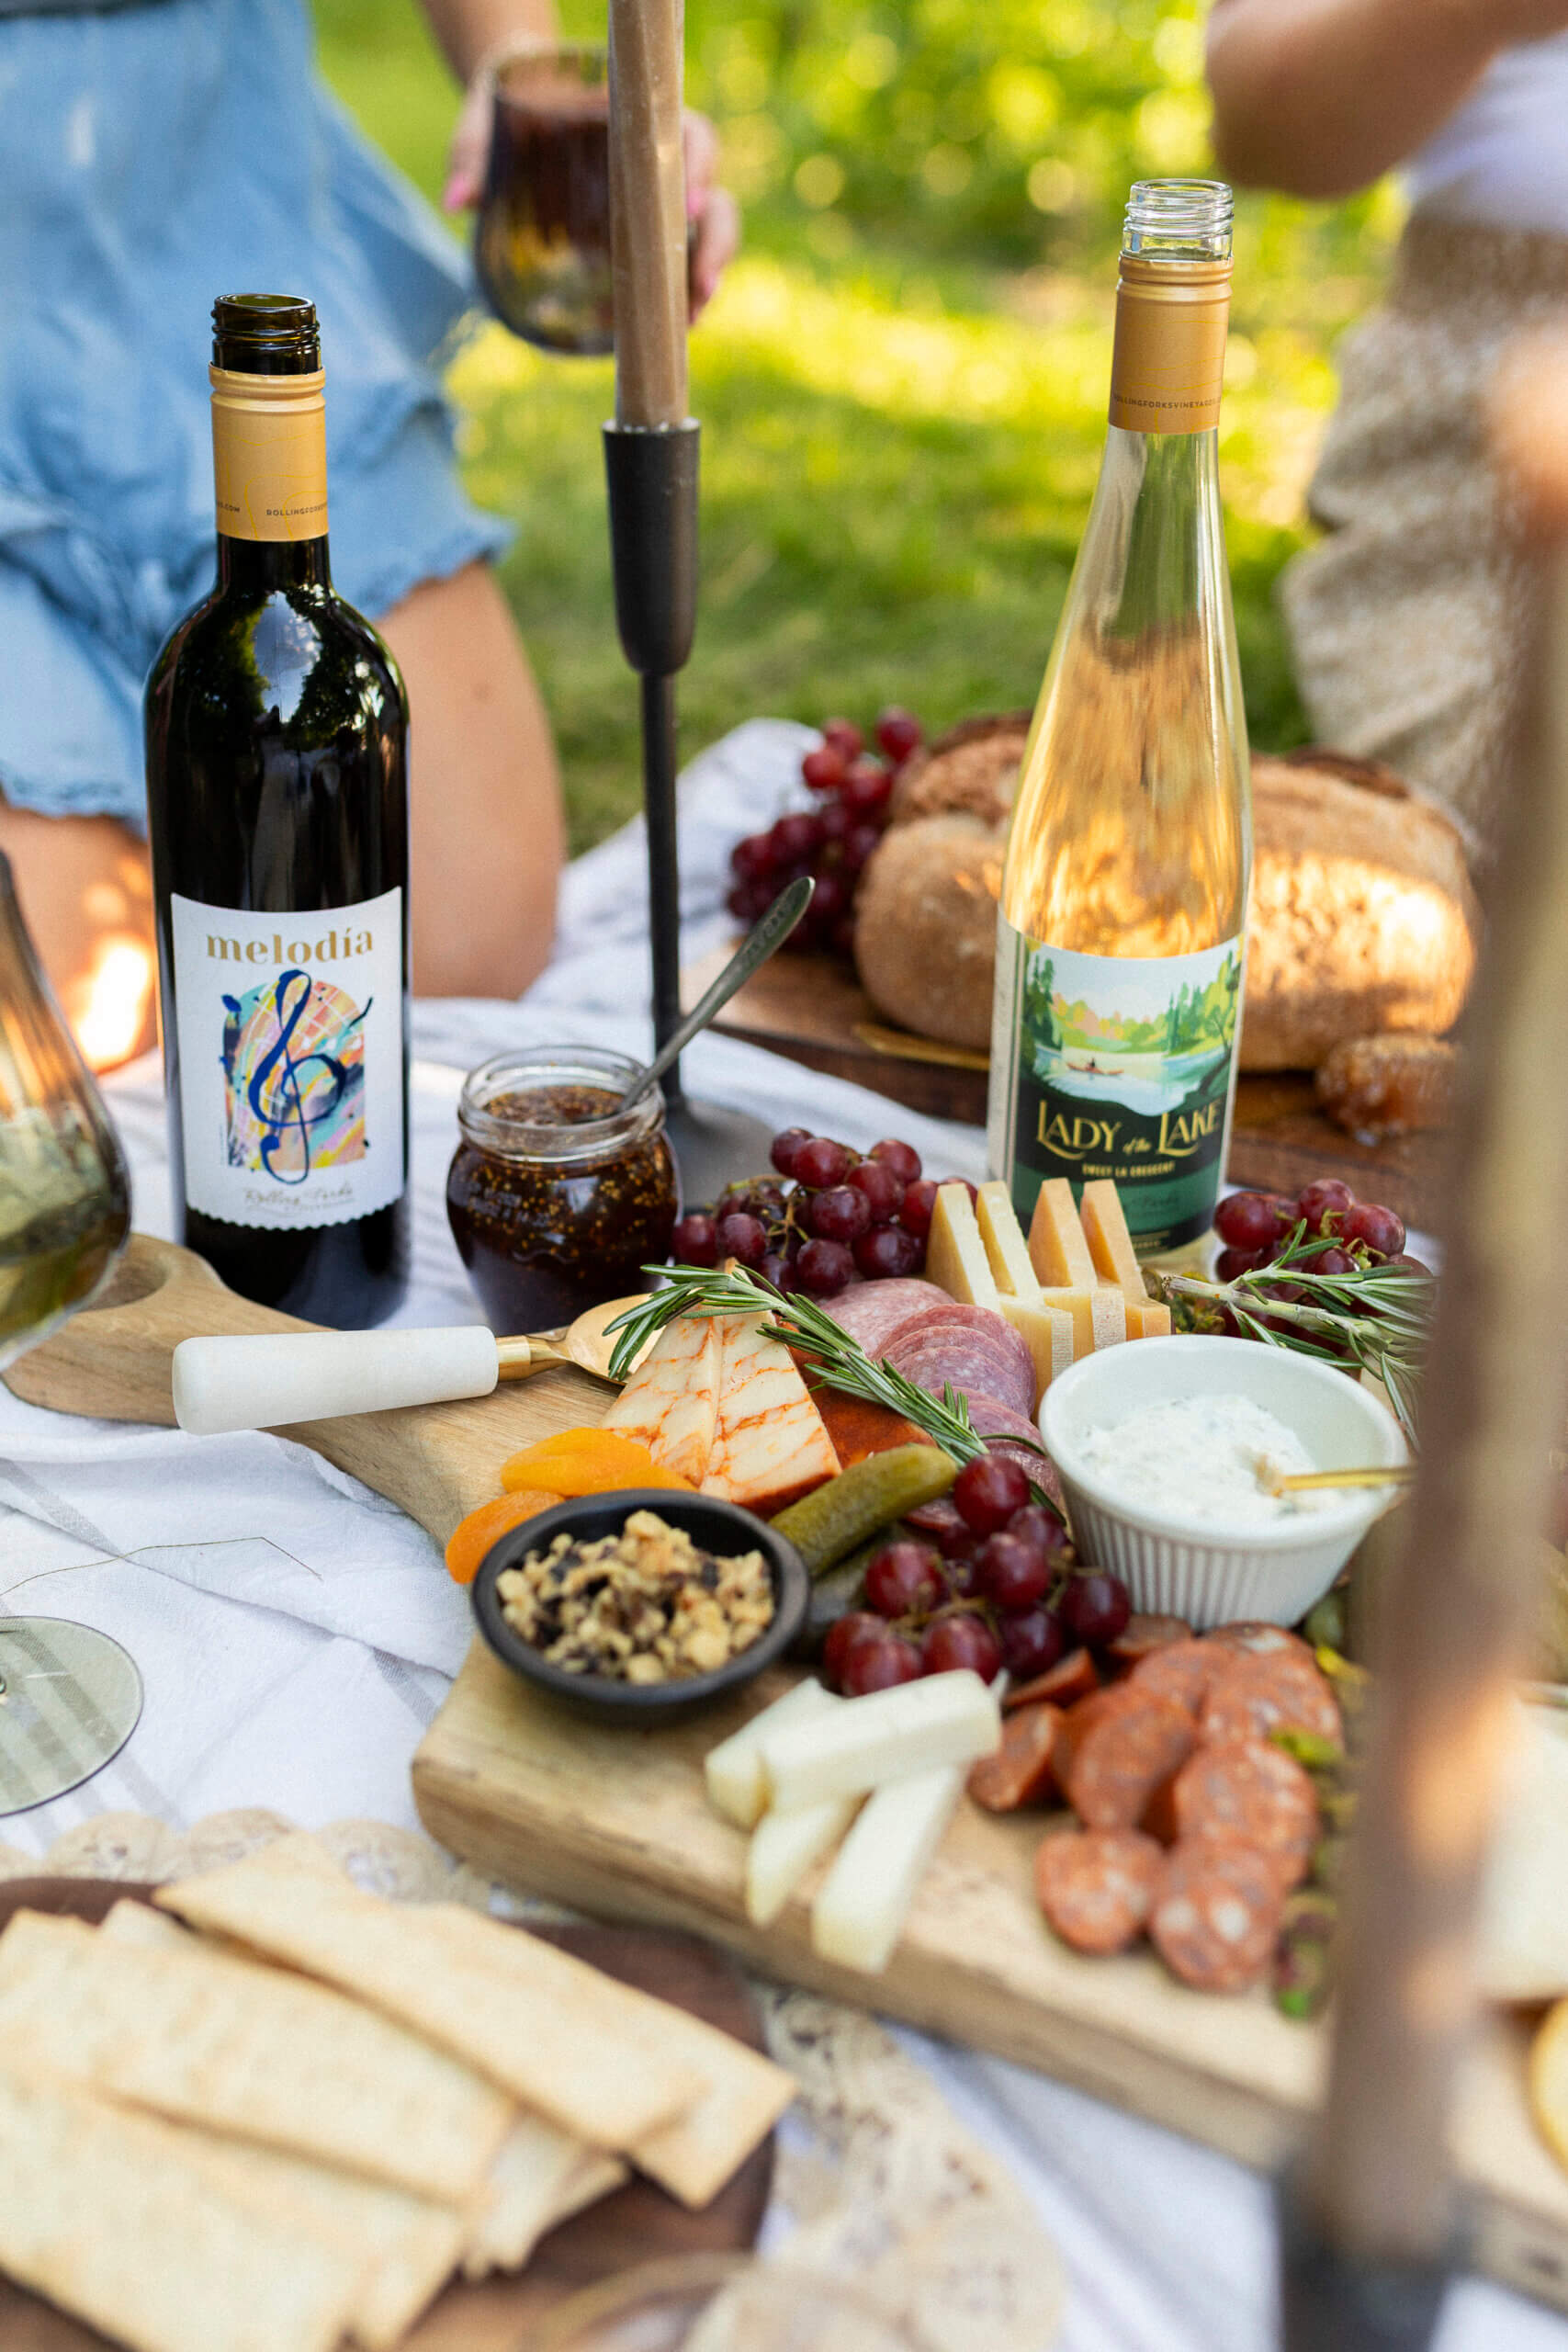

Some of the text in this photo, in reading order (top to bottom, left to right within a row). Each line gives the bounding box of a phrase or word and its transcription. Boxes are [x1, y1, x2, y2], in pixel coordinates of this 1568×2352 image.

[206, 927, 374, 965] melodía
[1037, 1099, 1122, 1160] LADY
[1156, 1099, 1221, 1157] LAKE
